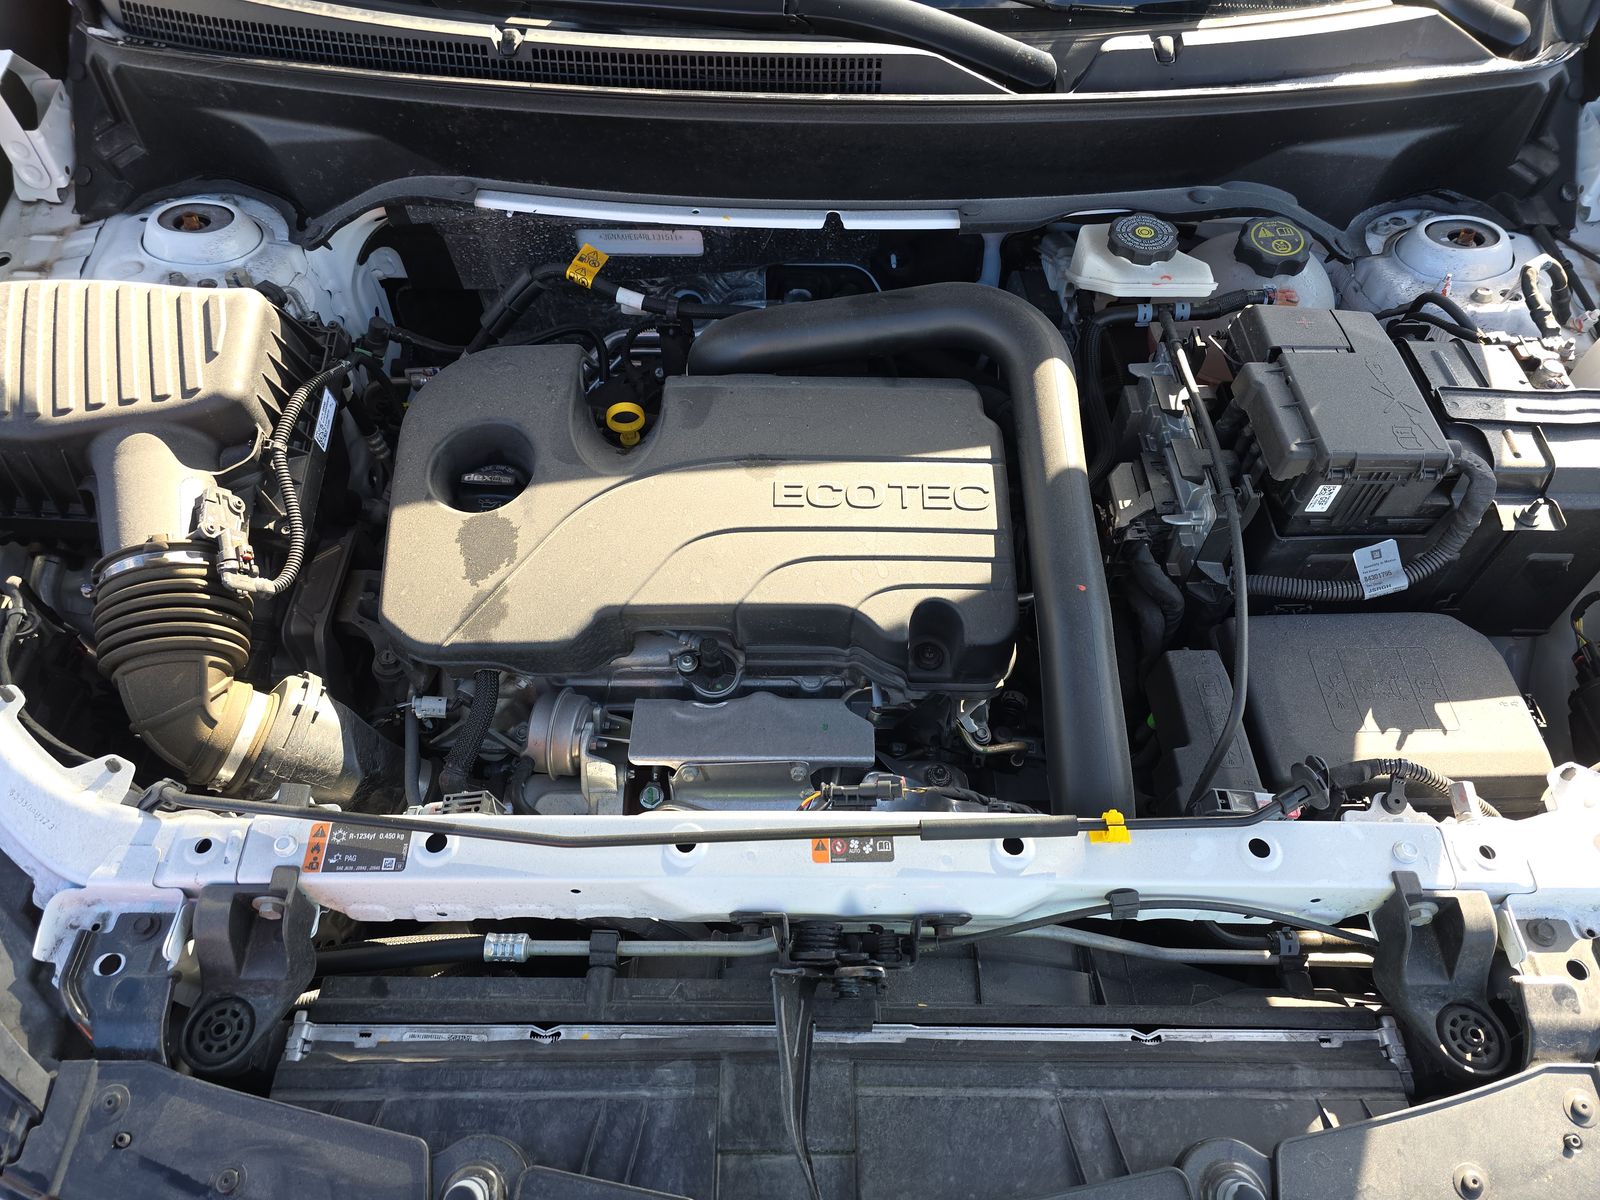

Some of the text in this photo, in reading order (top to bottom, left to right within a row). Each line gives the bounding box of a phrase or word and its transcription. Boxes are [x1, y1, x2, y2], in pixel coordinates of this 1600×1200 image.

[773, 481, 990, 511] ECOTEC
[349, 832, 376, 841] R-1234yf
[396, 832, 405, 840] kg
[344, 854, 357, 862] PAG
